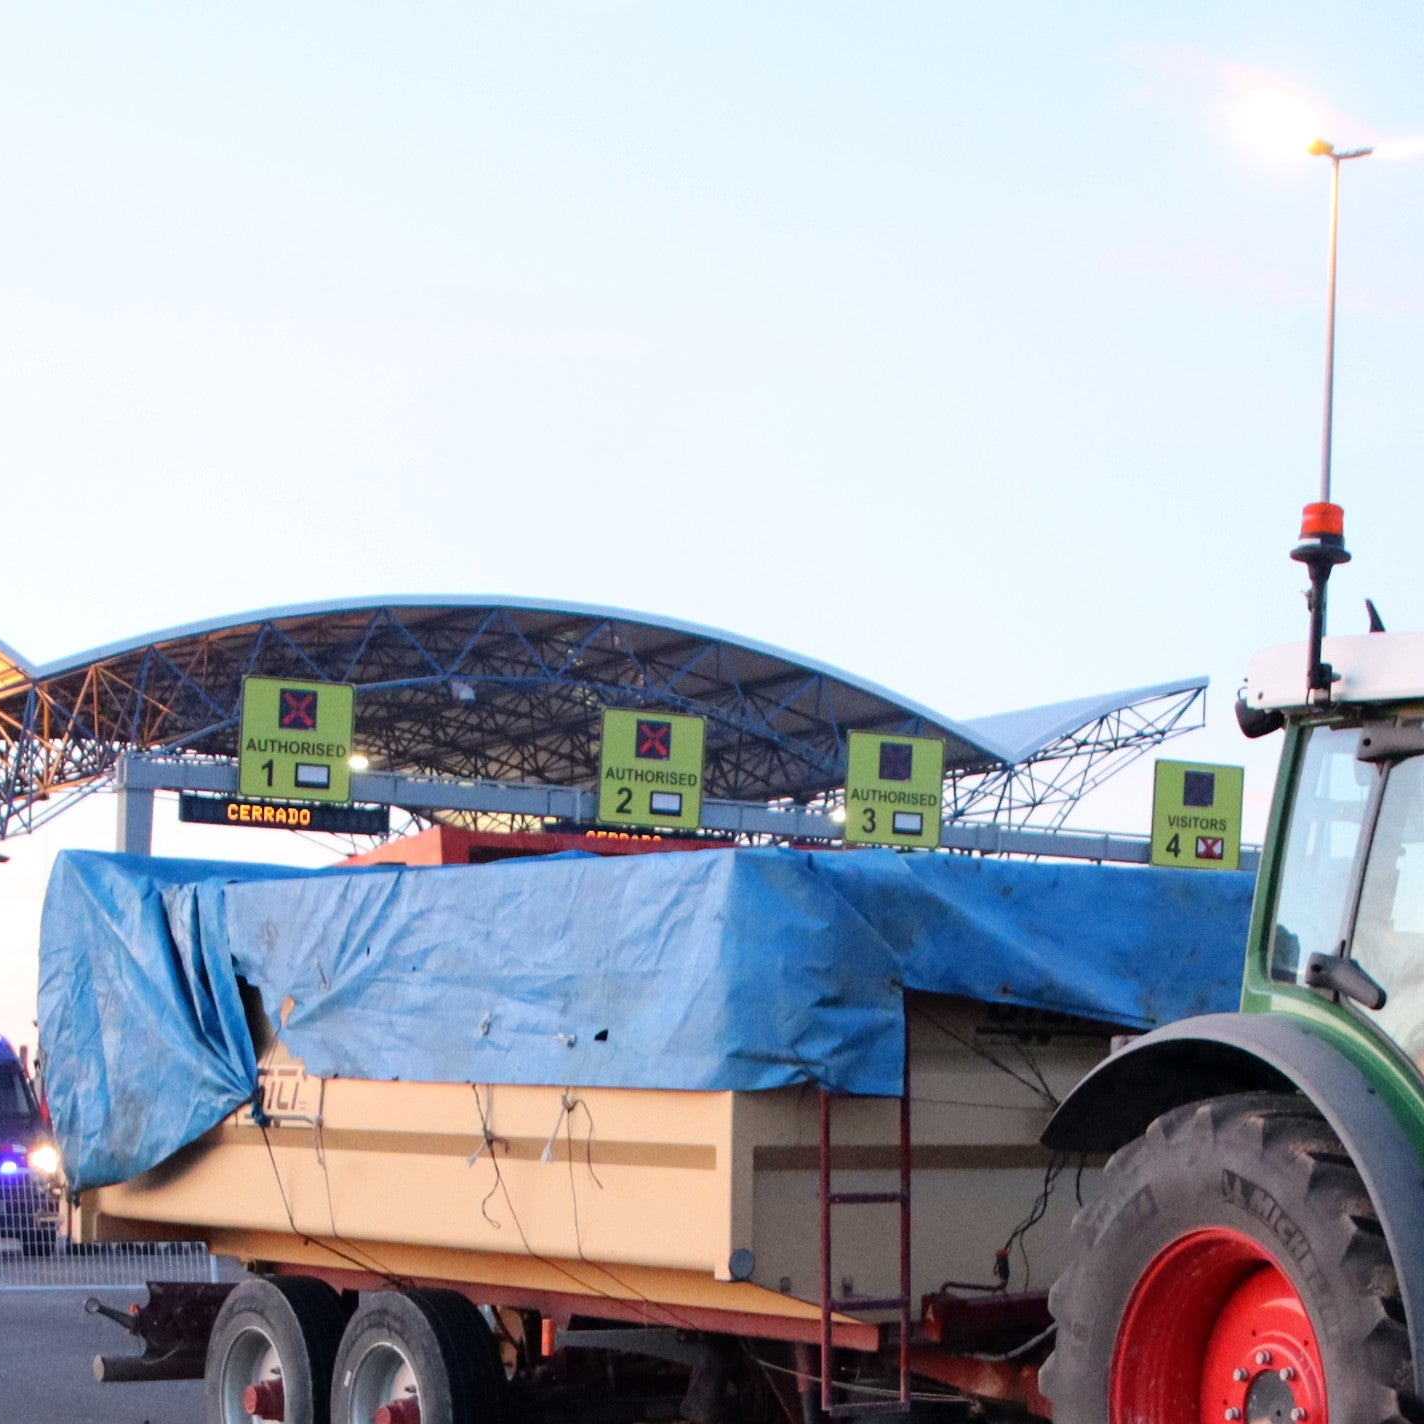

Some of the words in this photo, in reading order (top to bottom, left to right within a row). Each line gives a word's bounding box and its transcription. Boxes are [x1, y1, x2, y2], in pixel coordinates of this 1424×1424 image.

[246, 738, 346, 758] AUTHORISED
[261, 759, 274, 787] 1
[605, 767, 697, 786] AUTHORISED
[616, 787, 633, 814] 2
[851, 788, 937, 806] AUTHORISED
[227, 803, 311, 826] CERRADO
[862, 808, 875, 833] 3
[1168, 815, 1227, 831] VISITORS
[1166, 833, 1181, 858] 4
